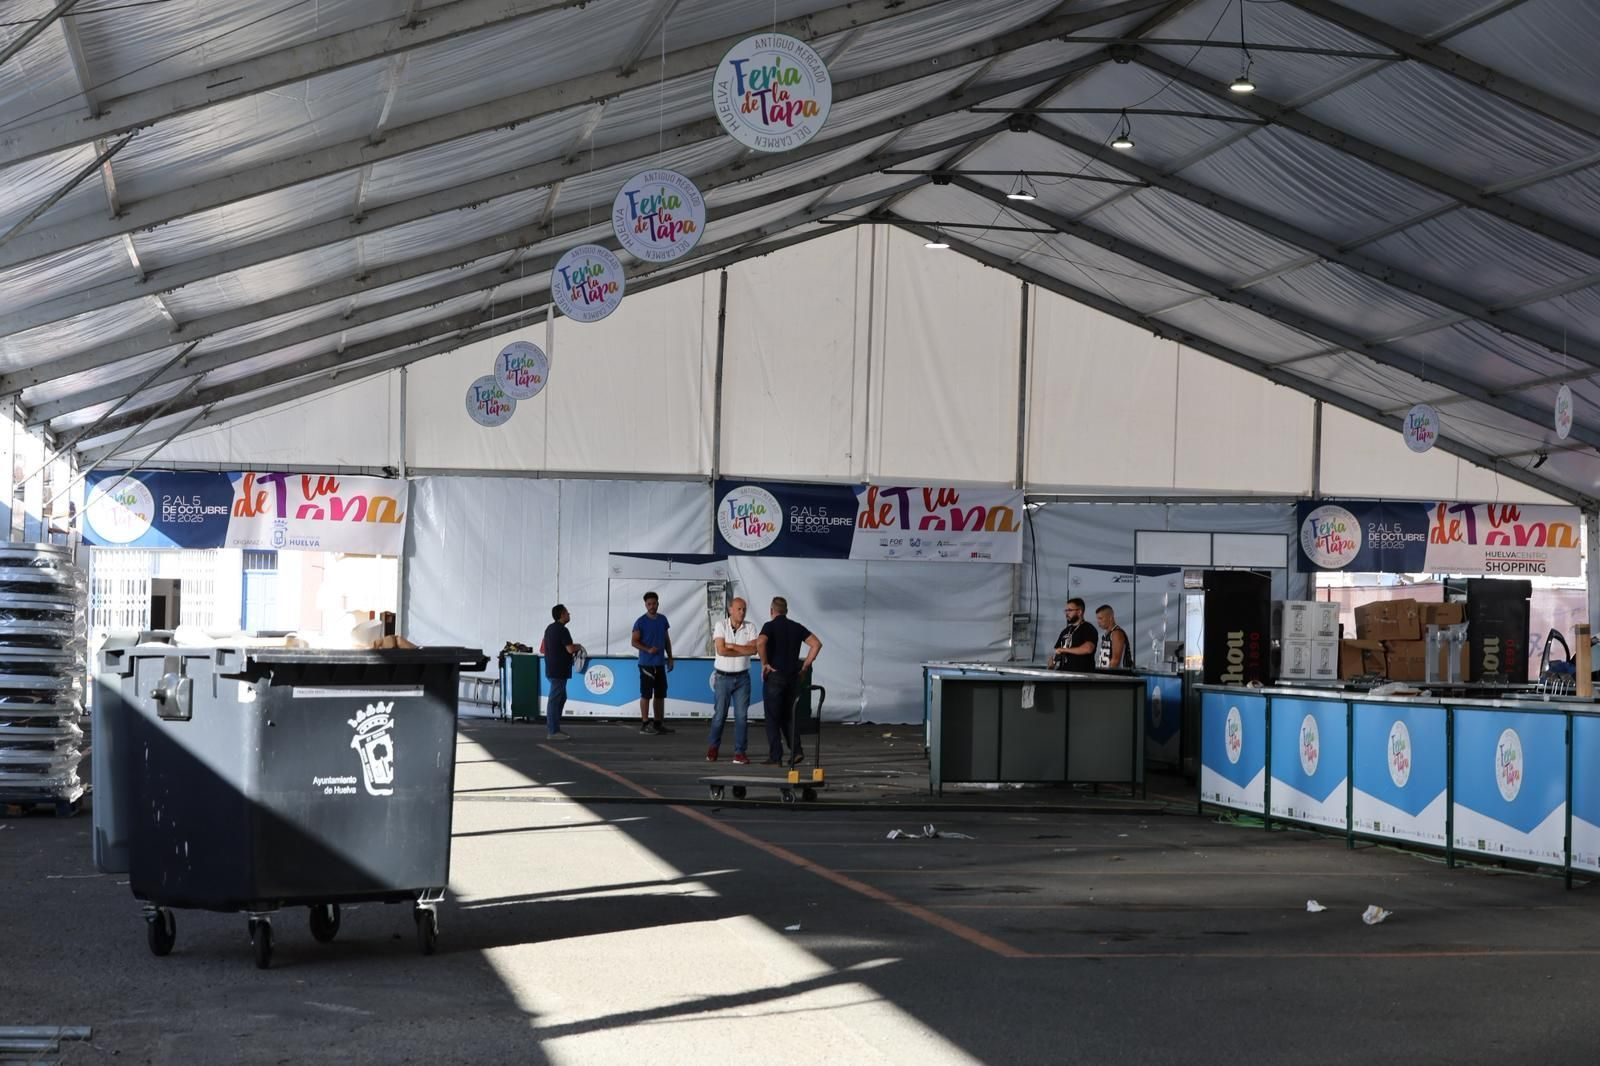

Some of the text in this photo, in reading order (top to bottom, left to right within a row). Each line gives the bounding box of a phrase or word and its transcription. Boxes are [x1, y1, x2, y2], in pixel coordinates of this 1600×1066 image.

[729, 56, 803, 97] Feria
[718, 37, 827, 149] ANTIGUO MERCADO DEL CARMEN HUELVA
[741, 80, 821, 128] de la Tapa
[644, 171, 677, 183] ANTIGUO
[675, 176, 702, 208] MERCADO
[624, 187, 682, 221] Feria
[615, 207, 635, 249] HUELVA
[634, 206, 697, 243] de la Tapa
[645, 249, 676, 260] CARMEN
[558, 258, 605, 292] Feria
[570, 275, 619, 306] de la Tapa
[503, 352, 535, 371] Feria
[511, 368, 542, 388] Tapa
[473, 384, 505, 403] Feria
[482, 399, 511, 417] Tapa
[162, 495, 201, 506] 2 AL 5
[233, 471, 273, 518] de
[162, 506, 228, 515] DE OCTUBRE
[727, 498, 767, 520] Feria
[790, 506, 828, 518] 2 AL 5
[858, 486, 895, 529] de
[162, 514, 204, 523] DE 2025
[739, 515, 776, 538] Tapa
[749, 512, 759, 524] la
[790, 517, 853, 526] DE OCTUBRE
[1430, 502, 1463, 545] de
[790, 524, 830, 534] DE 2025
[1309, 517, 1347, 540] Feria
[1368, 523, 1402, 533] 2 AL 5
[1368, 533, 1425, 542] DE OCTUBRE
[289, 540, 320, 548] HUELVA
[1321, 534, 1357, 555] Tapa
[1368, 541, 1405, 549] DE 2025
[1485, 562, 1546, 573] SHOPPING
[312, 776, 357, 786] Ayuntamiento
